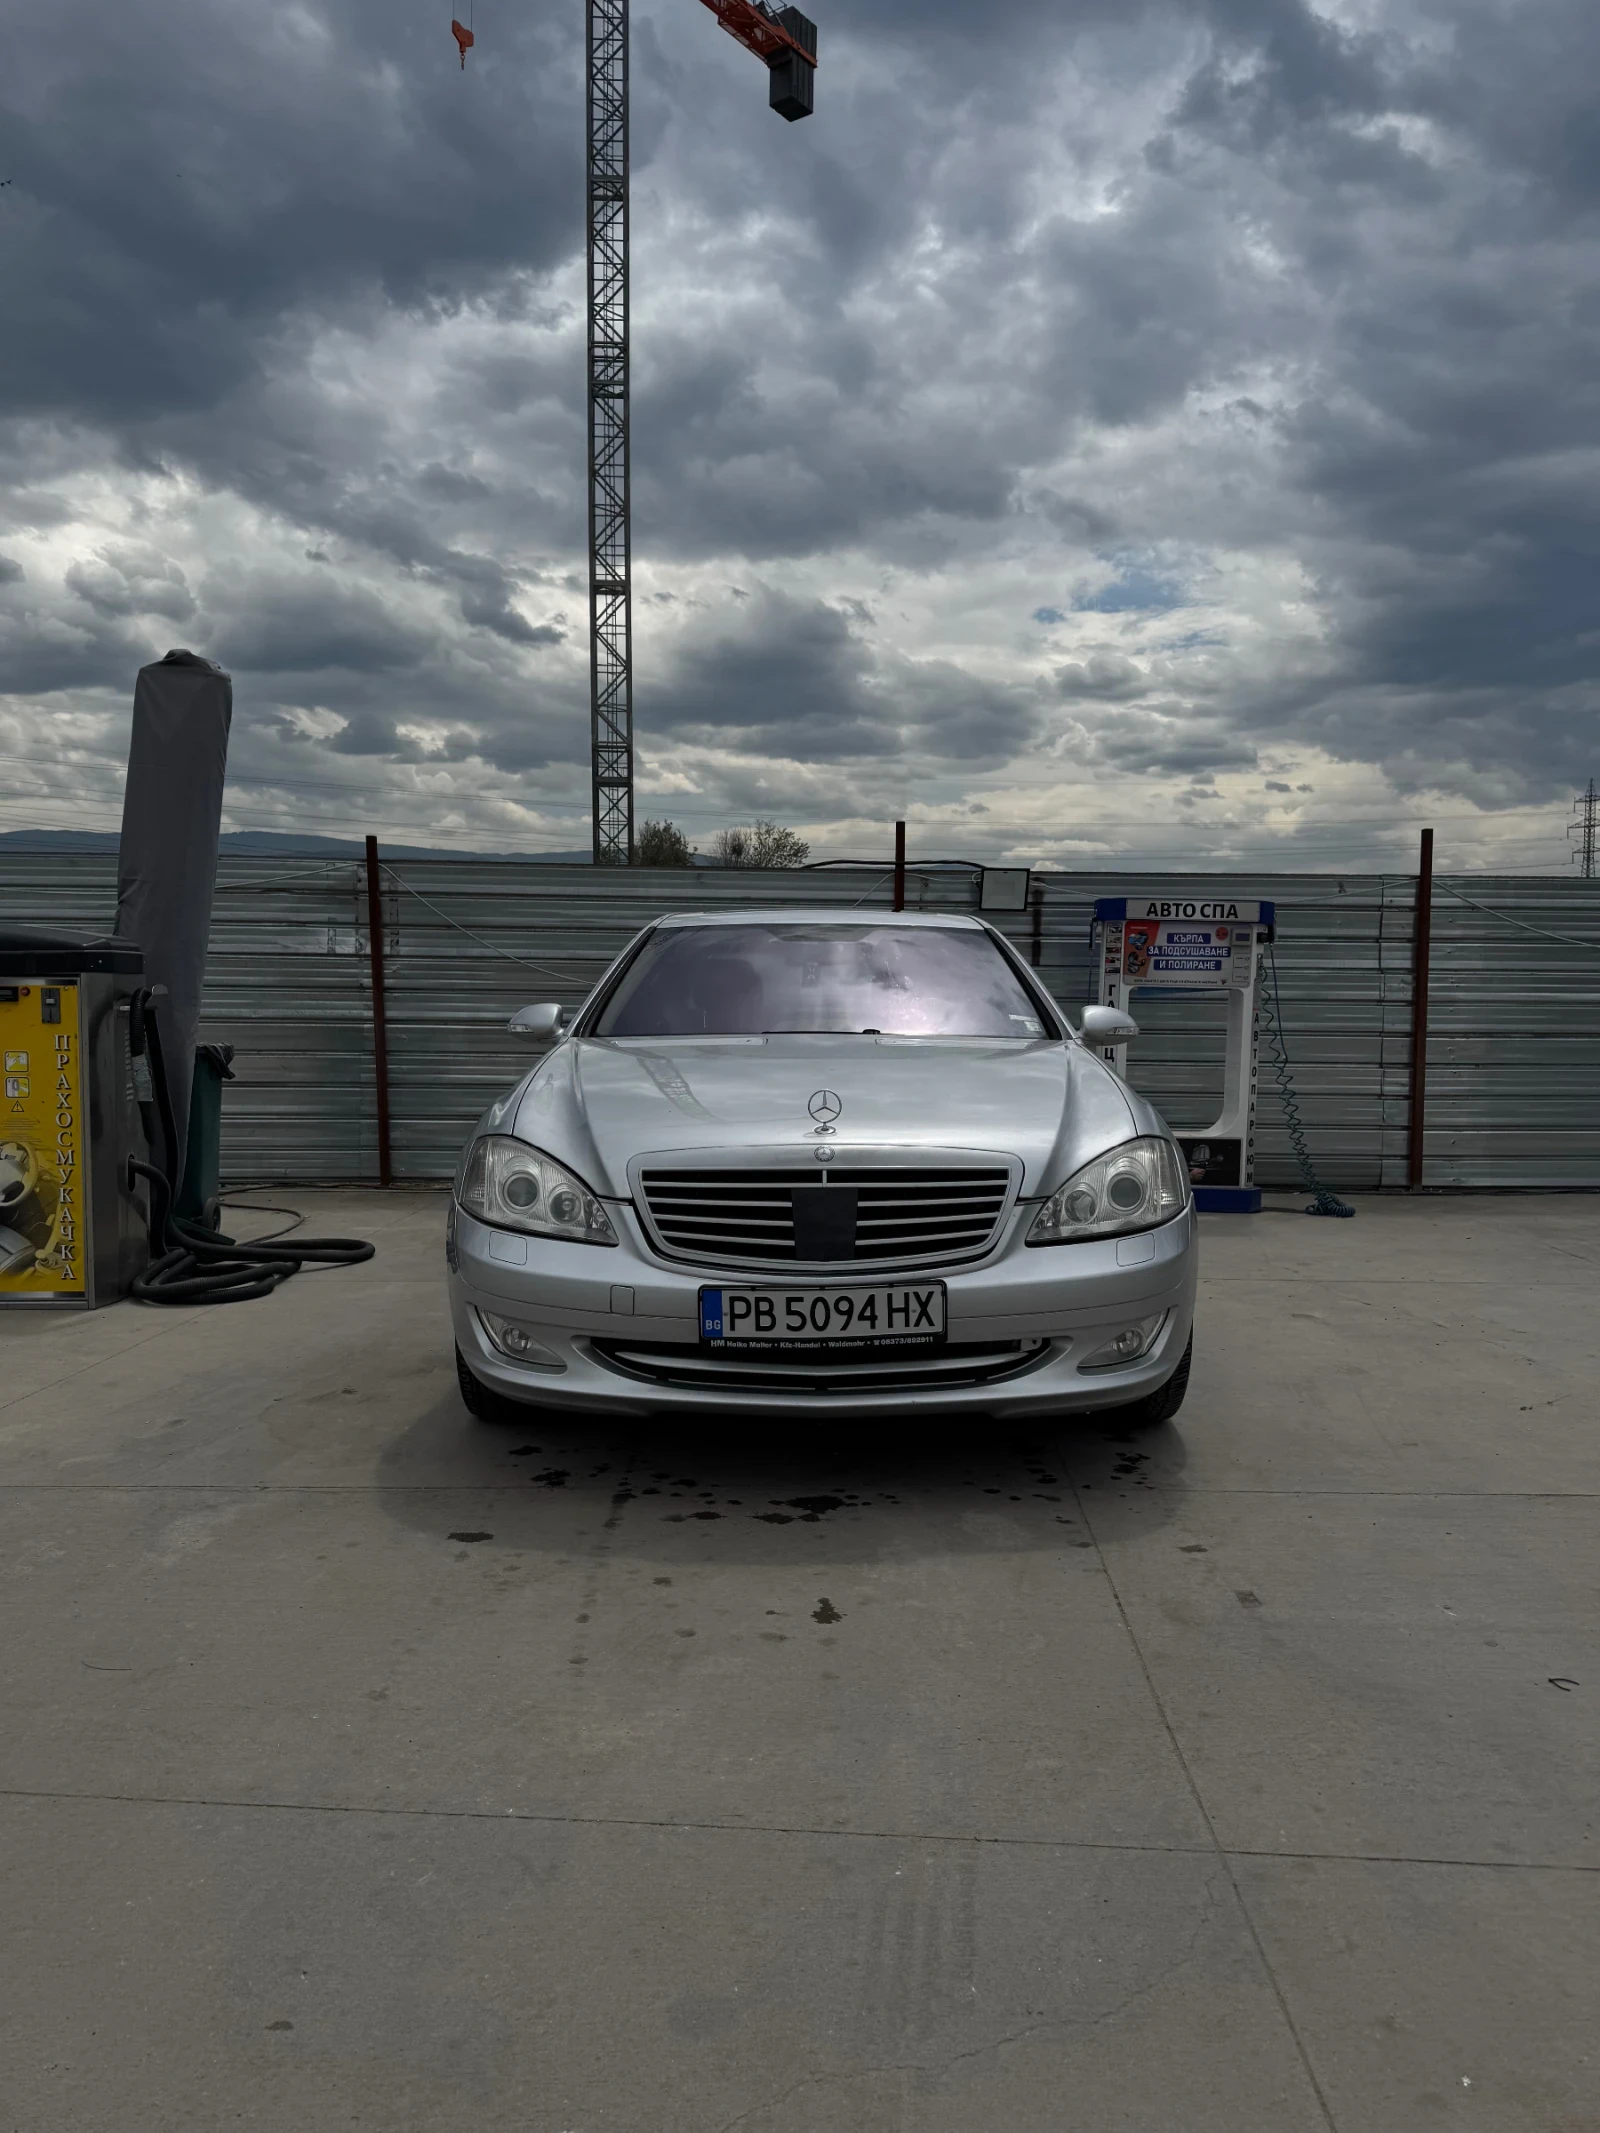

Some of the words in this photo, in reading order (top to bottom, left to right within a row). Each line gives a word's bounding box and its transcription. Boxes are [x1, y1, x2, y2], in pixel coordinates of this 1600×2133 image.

[1146, 902, 1196, 918] АВТО
[1199, 903, 1239, 919] СПА
[1173, 935, 1204, 943] КЪРПА
[1148, 946, 1160, 955] ЗА
[1161, 947, 1229, 957] ПОДСУШАВАНЕ
[1159, 961, 1166, 969] И
[1168, 961, 1216, 970] ПОЛИРАНЕ
[1246, 1012, 1260, 1184] АВТОПАРФЮМ
[54, 1034, 76, 1280] ПРАХОСМУКАЧКА
[705, 1319, 721, 1330] BG
[710, 1339, 725, 1347] HM
[828, 1339, 866, 1348] Waldmohr
